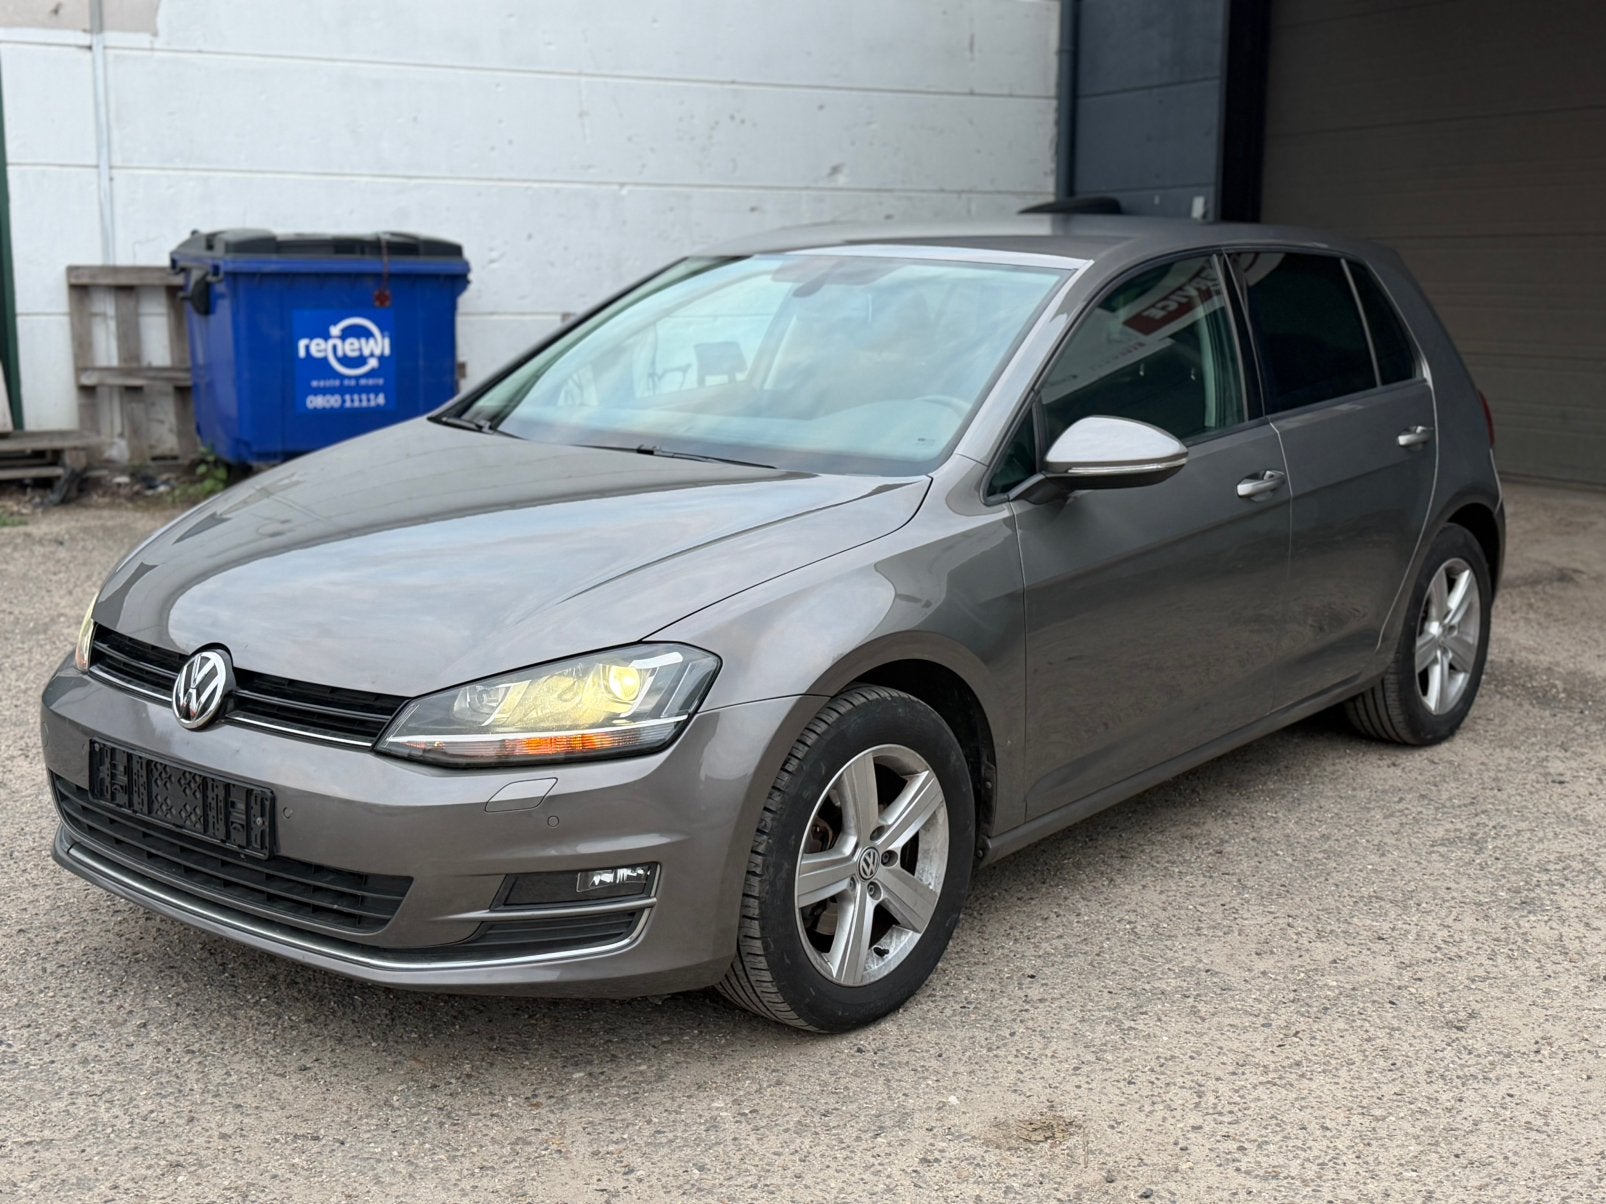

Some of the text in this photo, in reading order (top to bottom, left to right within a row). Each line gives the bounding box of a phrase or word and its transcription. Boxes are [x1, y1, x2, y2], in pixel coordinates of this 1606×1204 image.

[298, 331, 391, 359] renewi
[306, 392, 386, 409] 0800 11114
[173, 651, 227, 724] VW
[859, 847, 880, 880] VW
